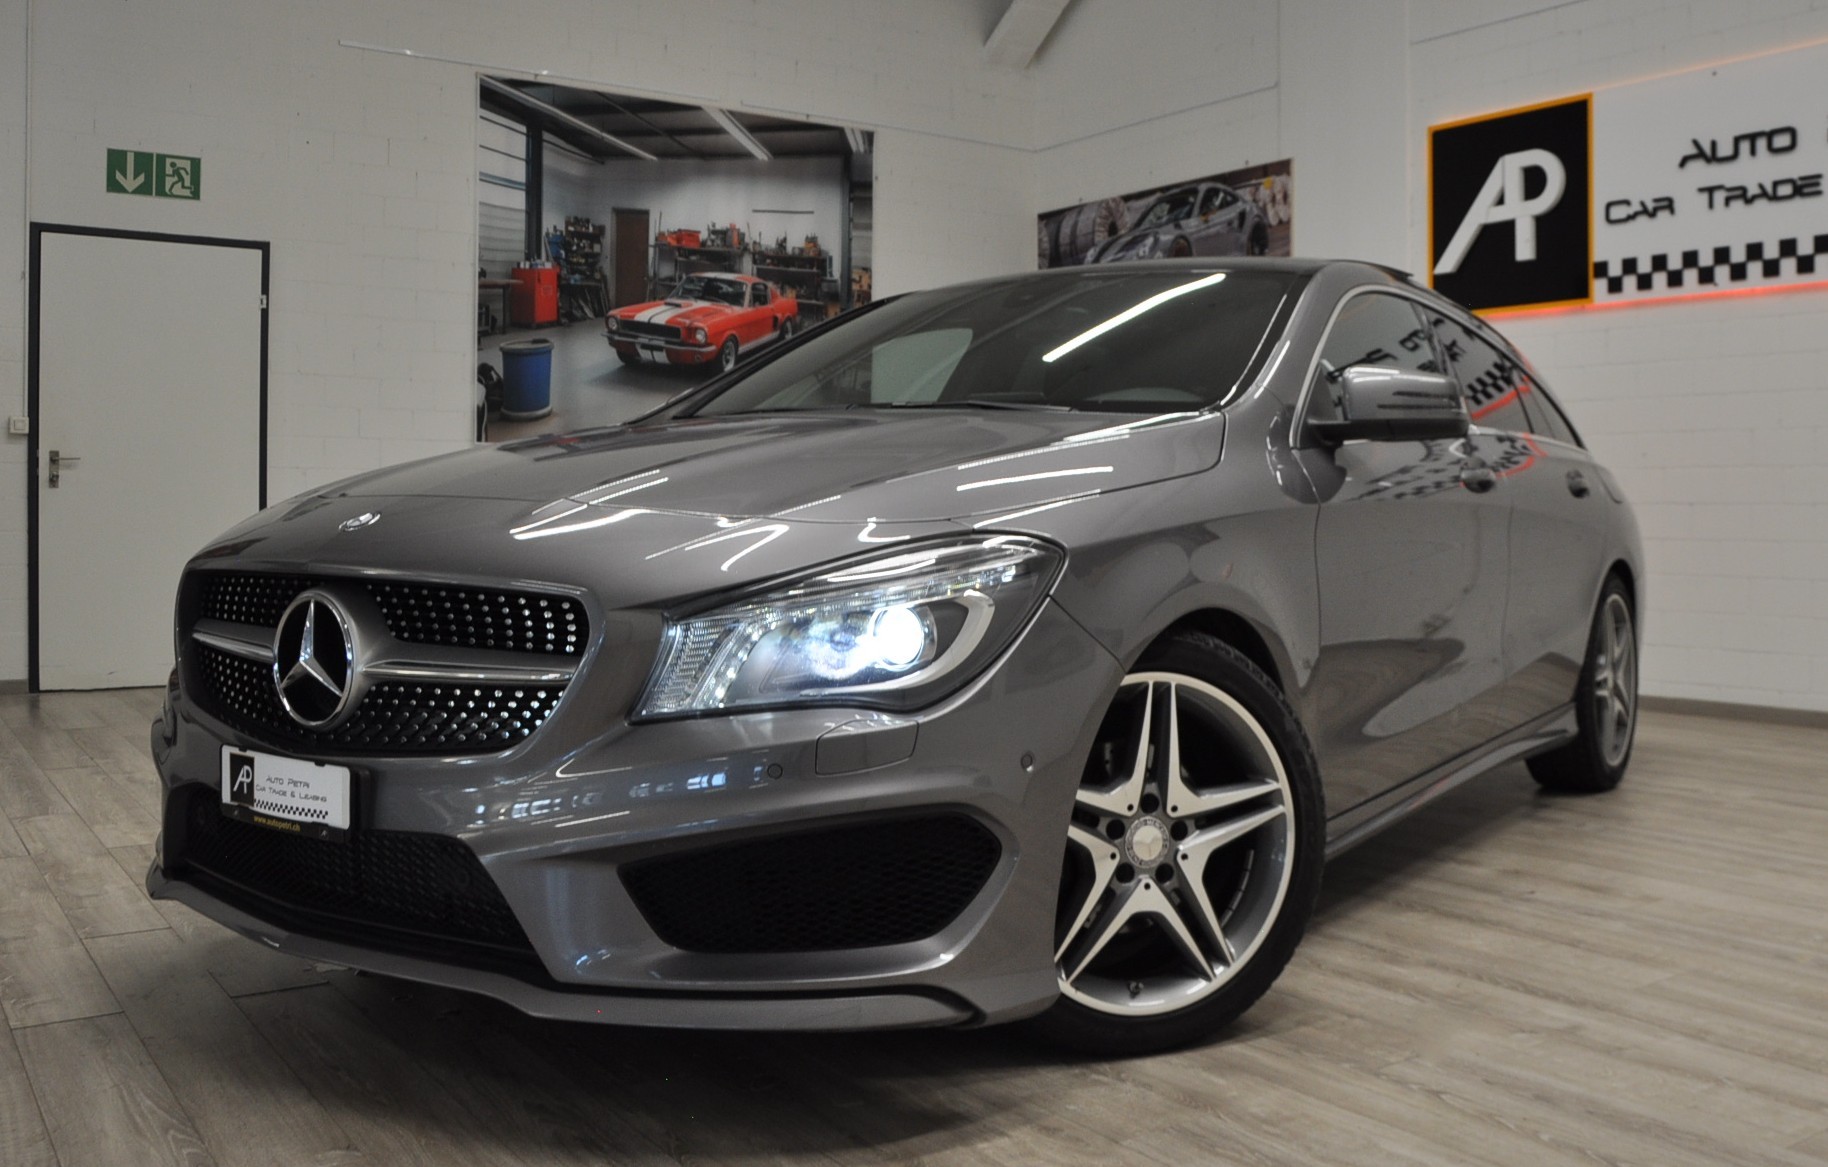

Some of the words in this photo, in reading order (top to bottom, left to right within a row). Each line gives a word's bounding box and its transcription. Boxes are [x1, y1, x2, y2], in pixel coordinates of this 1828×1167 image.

[1678, 126, 1798, 169] AUTO
[1433, 148, 1567, 275] AP
[1605, 196, 1676, 225] CAR
[1697, 173, 1824, 211] TRADE
